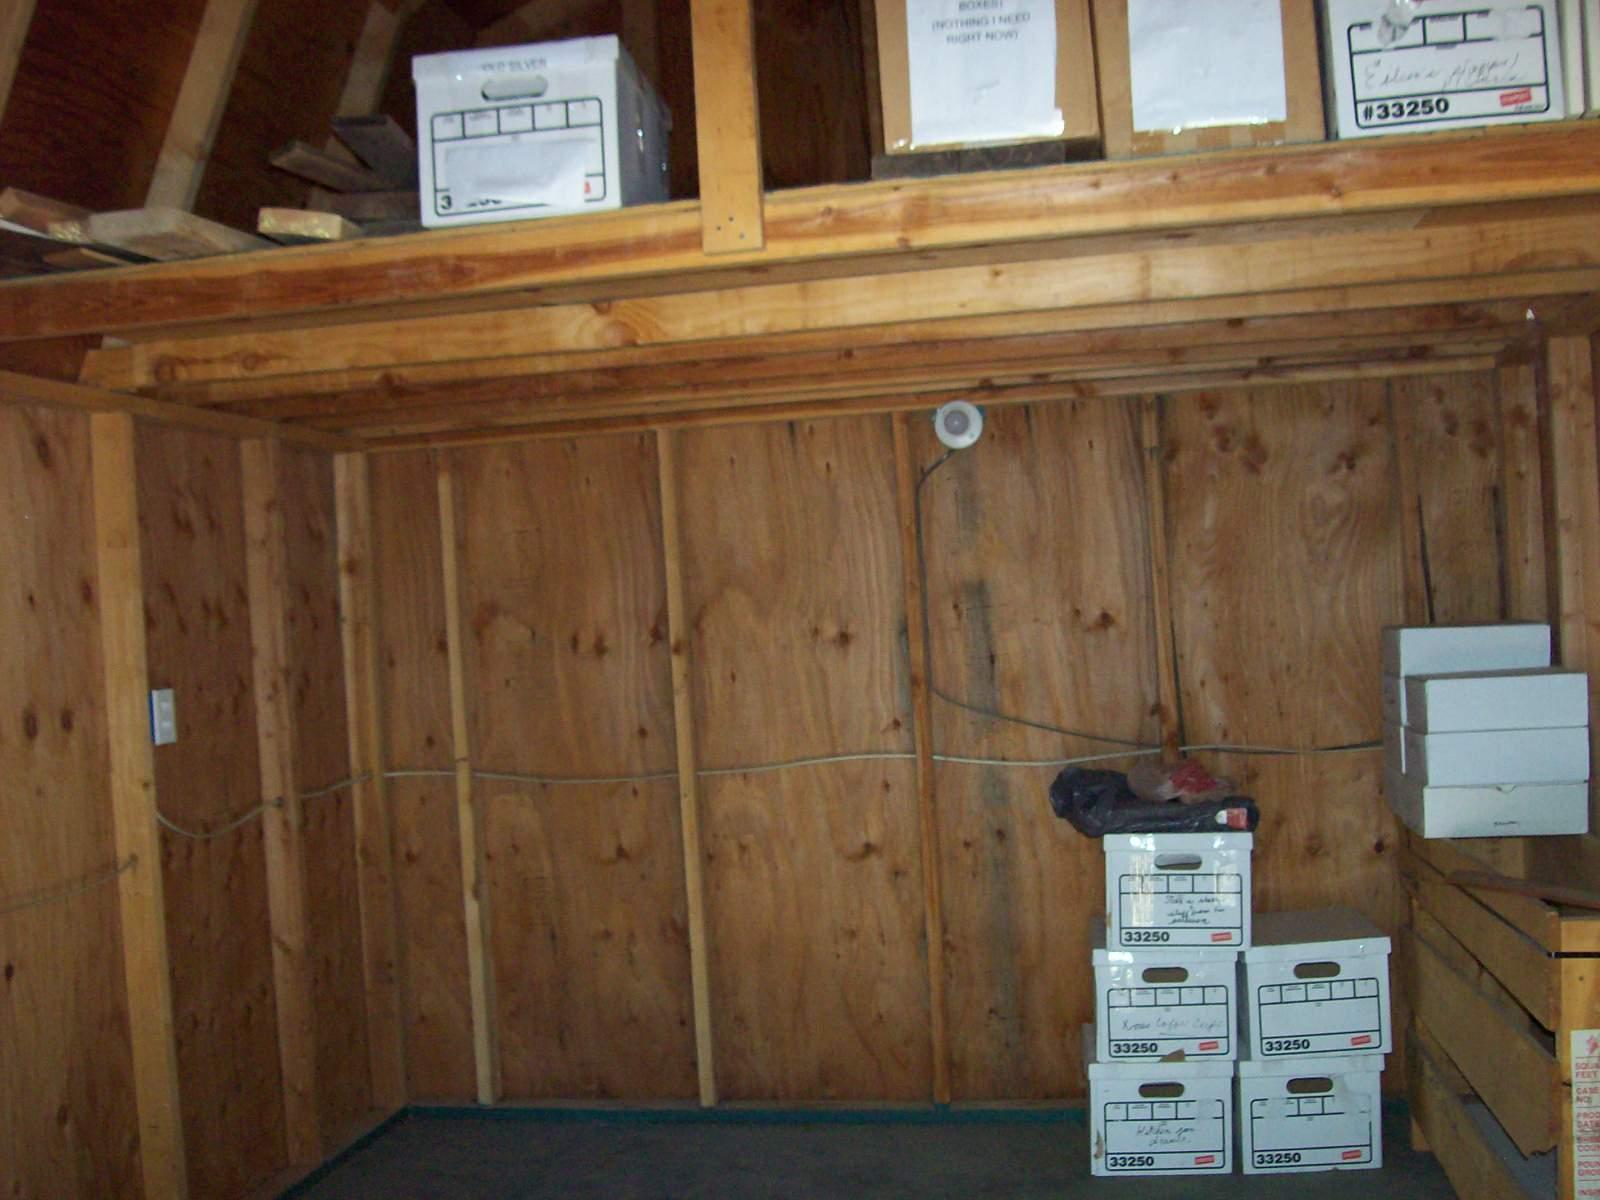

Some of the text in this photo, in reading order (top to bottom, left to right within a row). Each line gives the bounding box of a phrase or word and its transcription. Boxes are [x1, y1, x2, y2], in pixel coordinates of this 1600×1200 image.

[999, 12, 1031, 24] NEED
[946, 32, 982, 44] RIGHT
[1363, 97, 1450, 121] #33250
[1124, 931, 1170, 942] 33250
[1113, 1042, 1158, 1054] 33250
[1265, 1039, 1311, 1052] 33250
[1110, 1156, 1155, 1167] 33250
[1256, 1152, 1302, 1164] 33250
